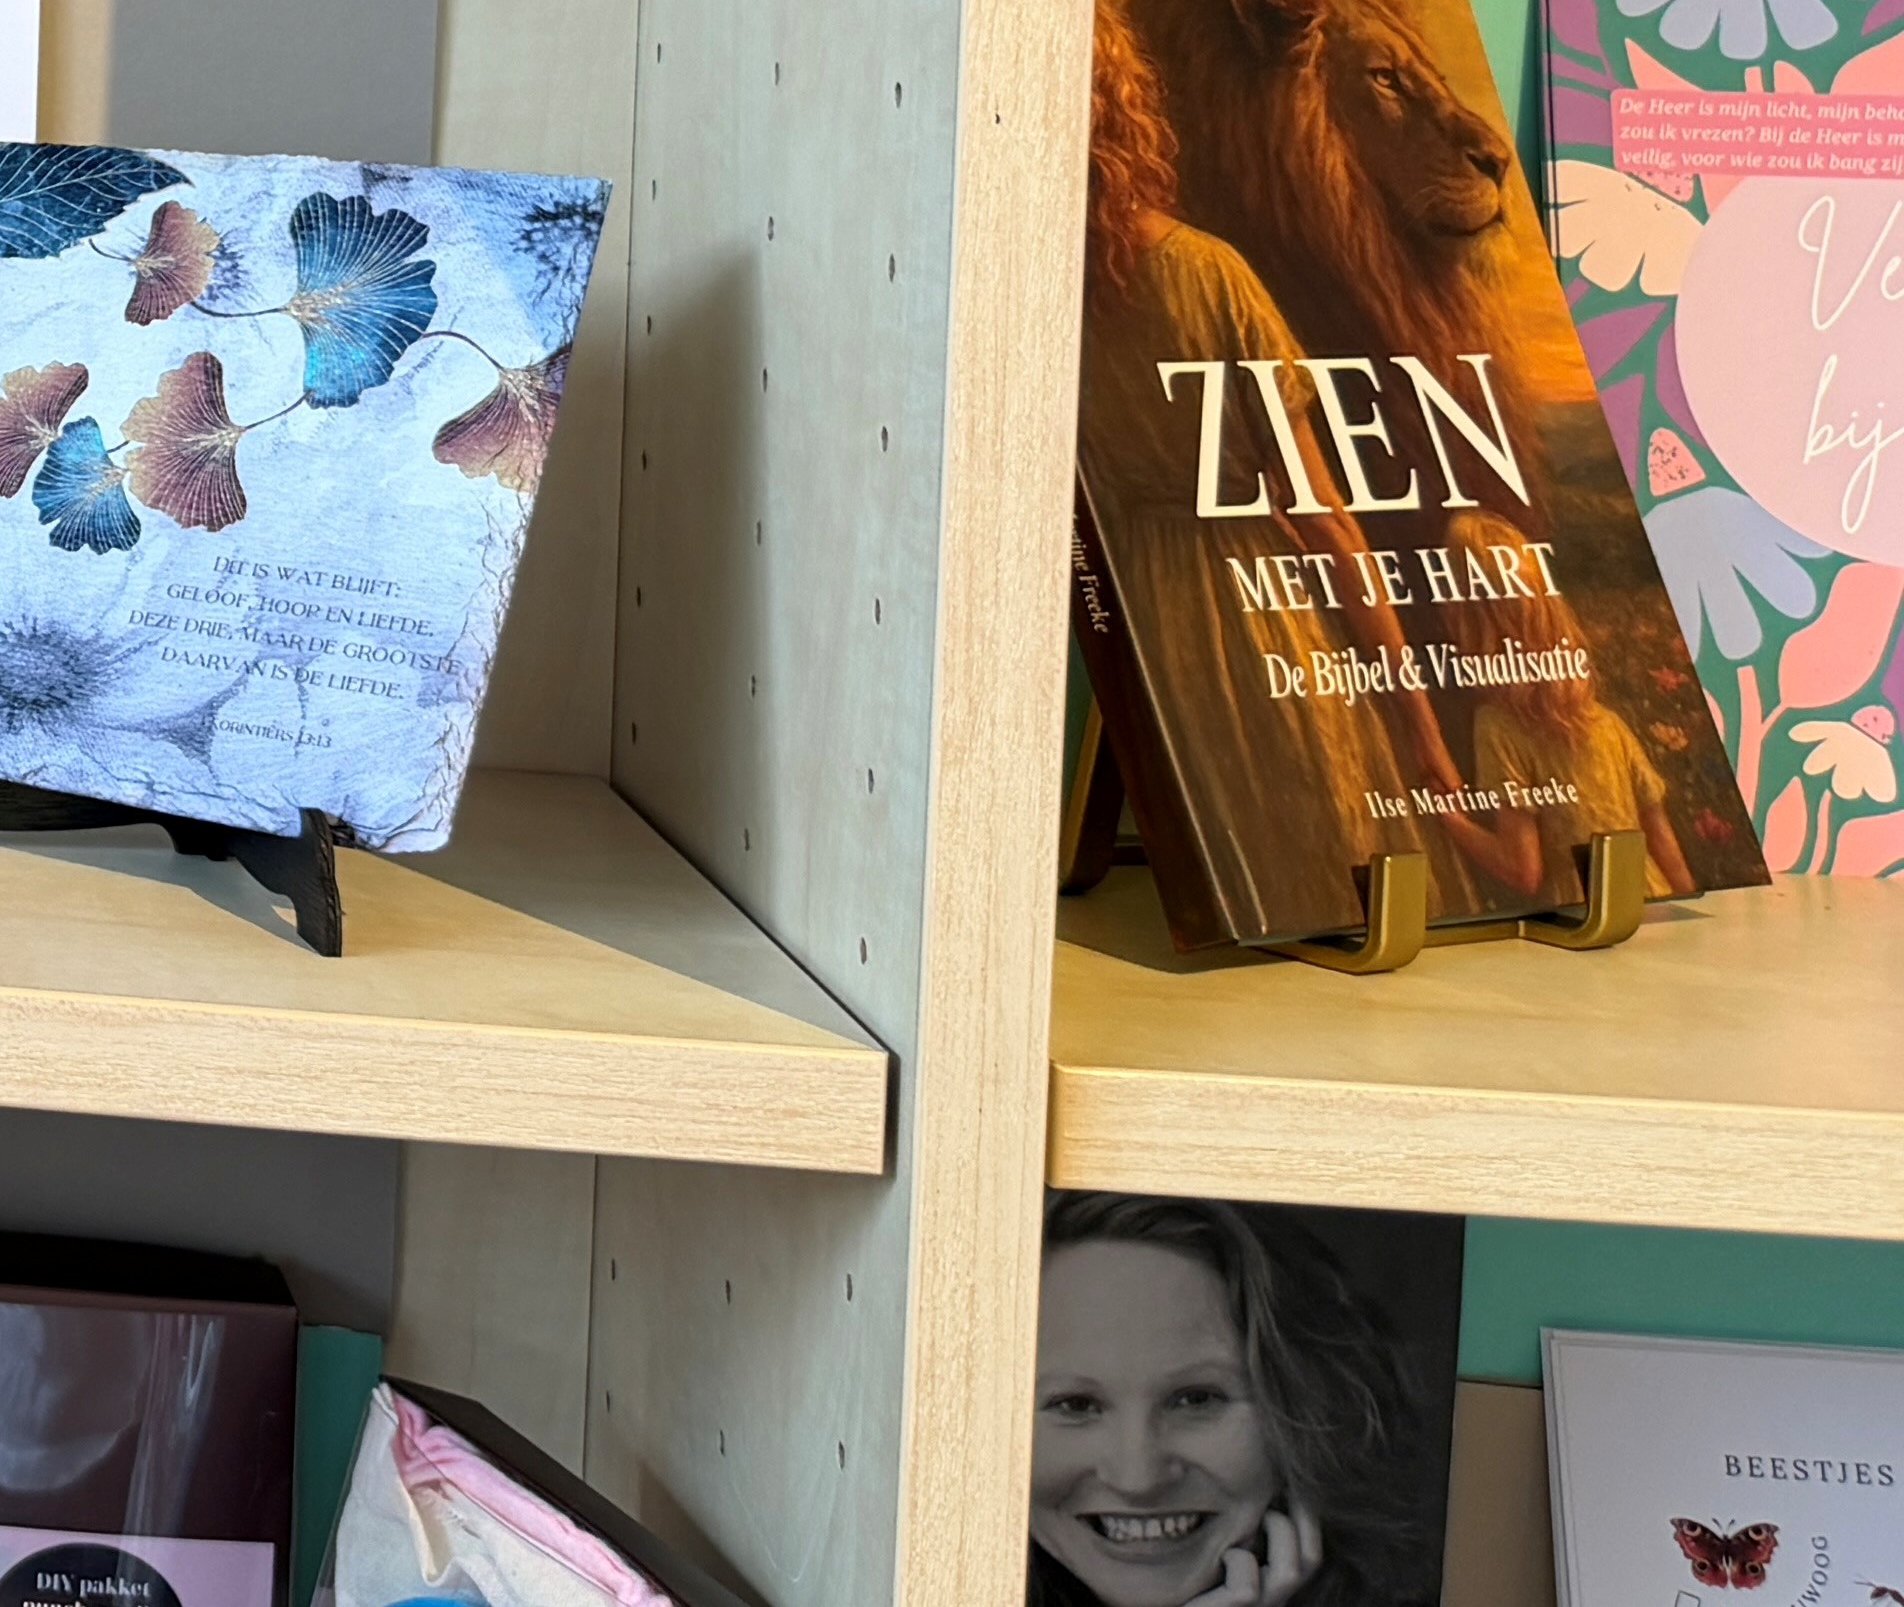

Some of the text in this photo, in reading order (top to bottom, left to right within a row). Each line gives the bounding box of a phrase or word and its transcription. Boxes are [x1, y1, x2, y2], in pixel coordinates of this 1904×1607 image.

[1620, 97, 1645, 115] De
[1648, 98, 1695, 115] Heer
[1699, 99, 1714, 116] is
[1719, 101, 1761, 120] mijn
[1818, 103, 1860, 122] mijn
[1157, 353, 1531, 519] ZIEN
[213, 556, 249, 578] DIT
[252, 563, 270, 580] IS
[278, 566, 328, 586] WAT
[1226, 542, 1561, 613] MET JE HART
[1263, 638, 1590, 706] De Bijbel & Visualisatie
[1364, 778, 1579, 819] Ilse Martine Freeke
[1725, 1455, 1894, 1486] BEESTJES
[36, 1572, 151, 1598] DIY pakket
